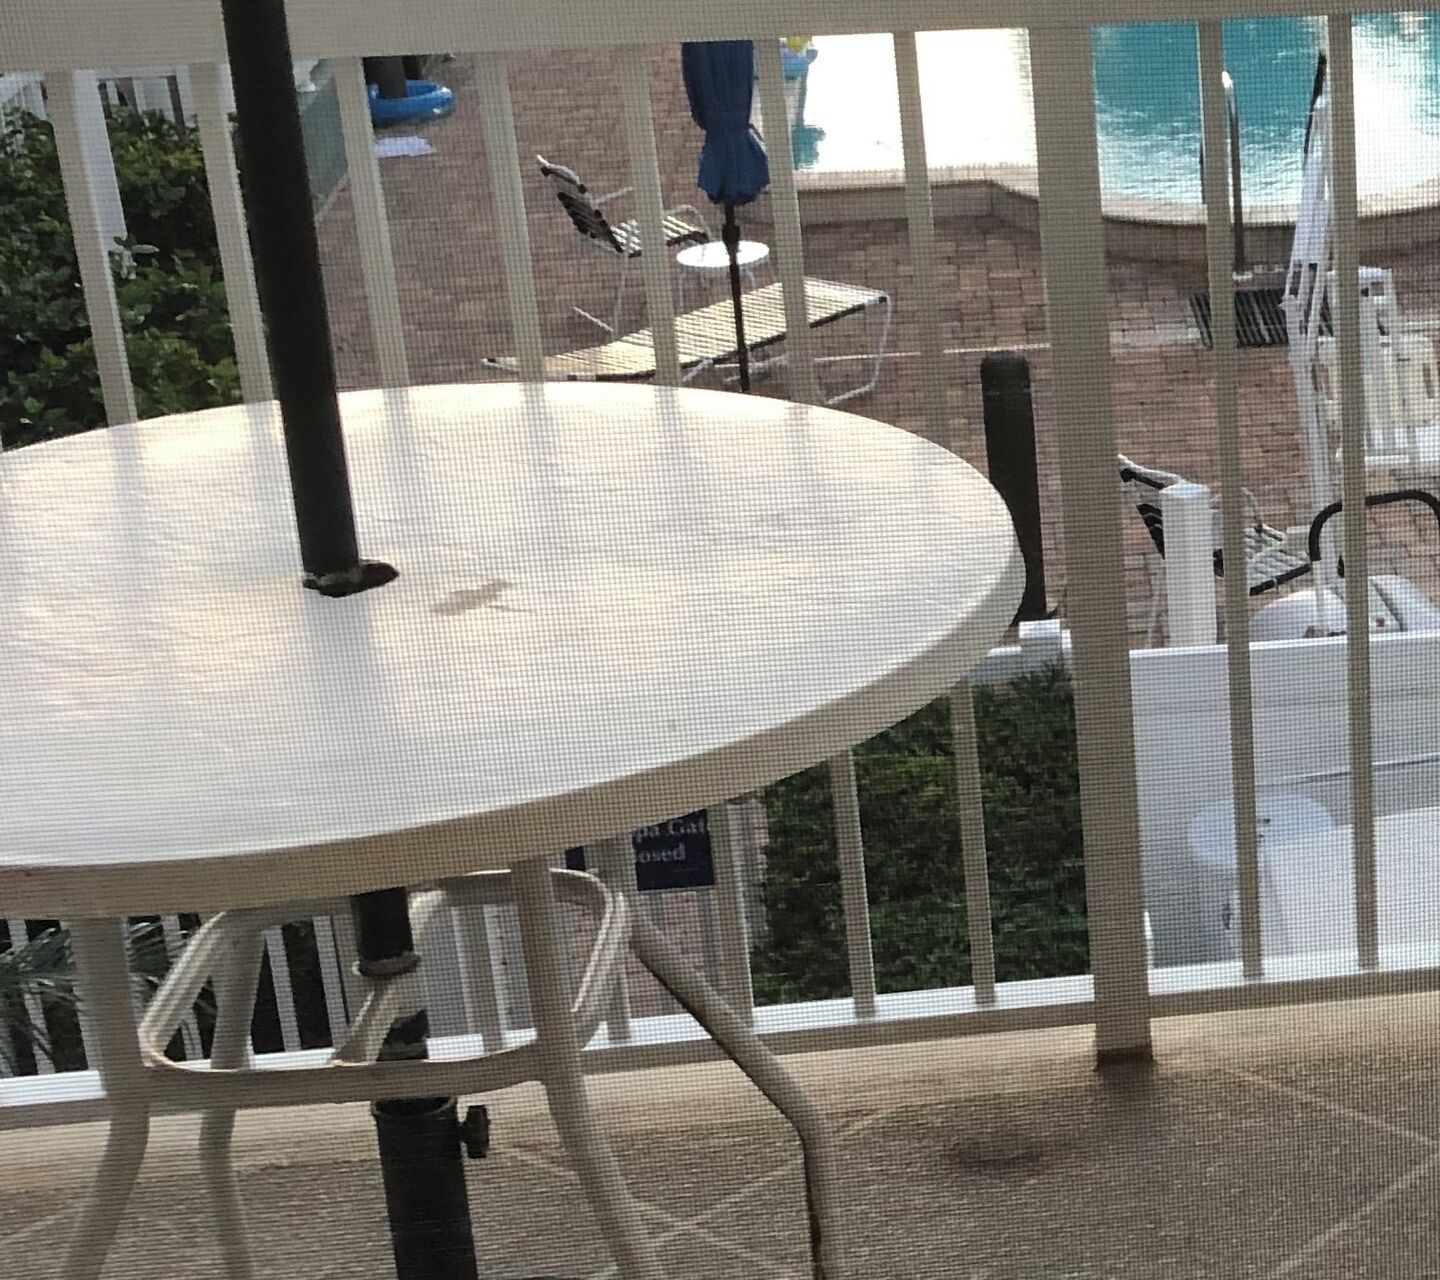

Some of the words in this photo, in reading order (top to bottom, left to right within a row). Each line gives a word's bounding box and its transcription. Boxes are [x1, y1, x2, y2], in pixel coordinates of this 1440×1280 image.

[635, 825, 661, 843] pa
[668, 817, 706, 835] Gat
[637, 841, 686, 863] osed
